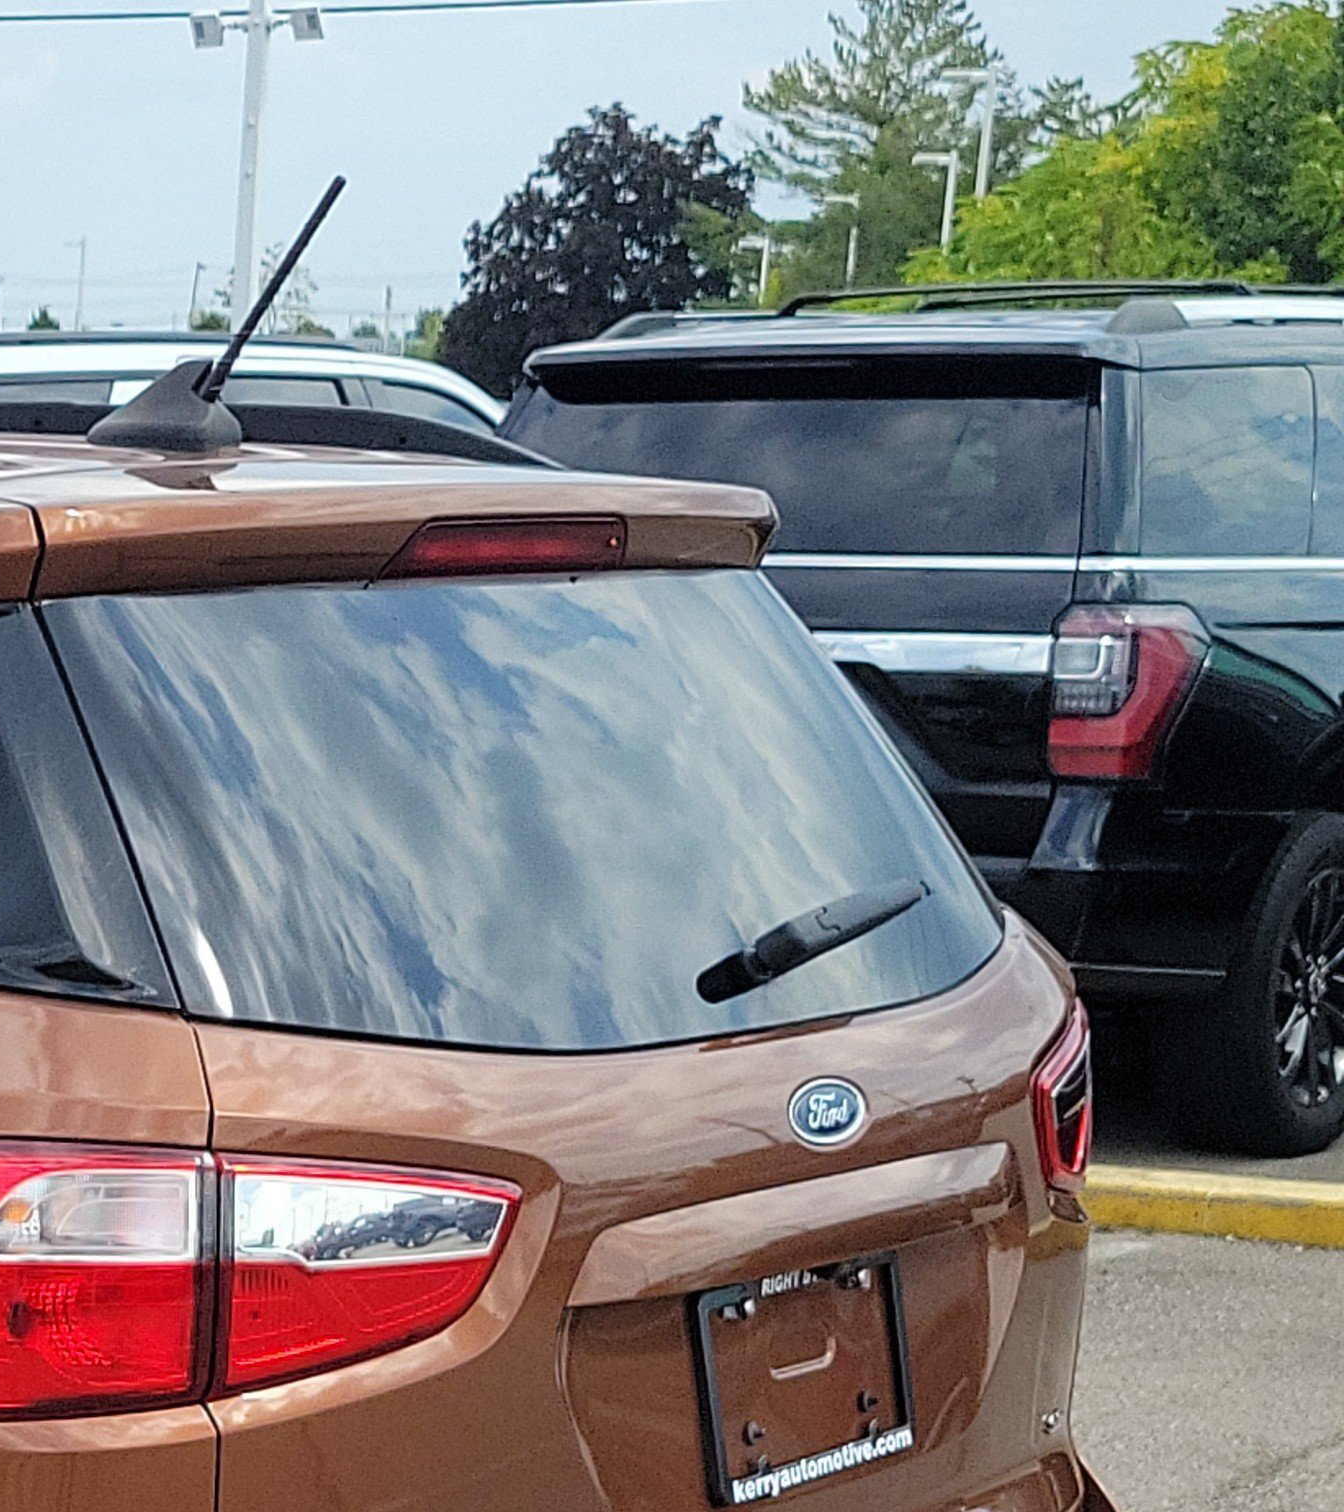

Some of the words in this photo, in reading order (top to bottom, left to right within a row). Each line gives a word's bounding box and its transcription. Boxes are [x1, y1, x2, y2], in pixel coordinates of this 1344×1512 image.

[808, 1091, 849, 1129] Ford
[761, 1269, 802, 1297] RIGHT
[732, 1428, 914, 1503] kerryautomotive.com
